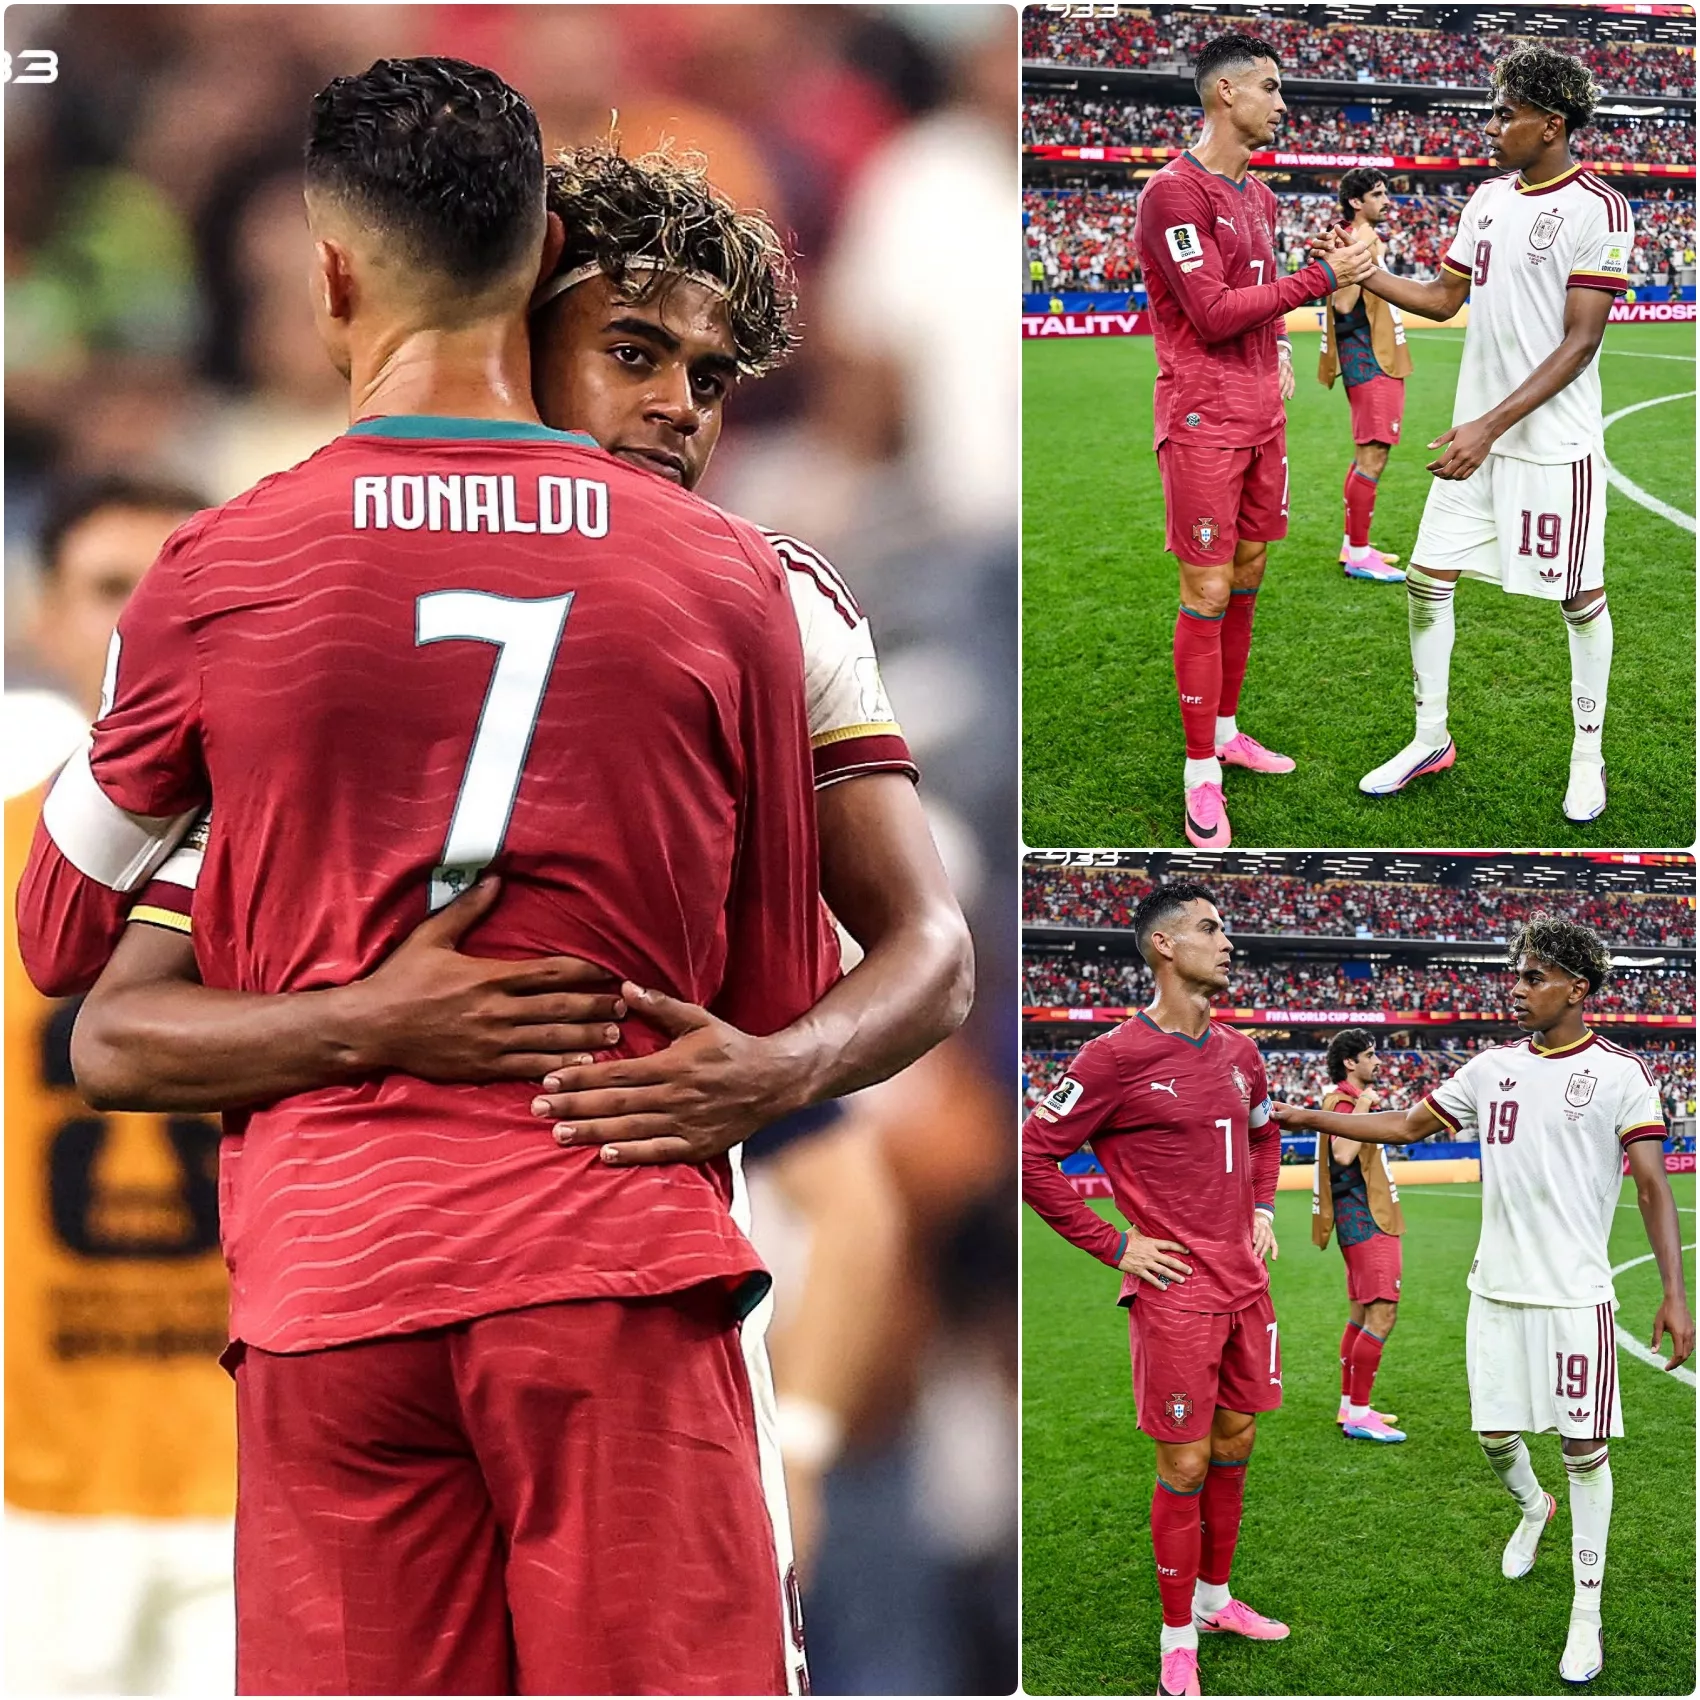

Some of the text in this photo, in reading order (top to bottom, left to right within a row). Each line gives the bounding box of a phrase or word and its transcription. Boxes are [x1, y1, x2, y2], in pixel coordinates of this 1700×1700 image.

[1275, 154, 1299, 164] FIFA
[1299, 155, 1337, 165] WORLD
[1337, 156, 1358, 166] CUP
[1249, 259, 1265, 286] 7
[1022, 314, 1139, 335] TALITY
[353, 473, 610, 539] RONALDO
[1518, 509, 1562, 559] 19
[415, 588, 576, 914] 7
[1265, 1011, 1386, 1022] FIFA WORLD CUP 2026
[1214, 1117, 1233, 1174] 7
[1486, 1100, 1520, 1145] 19
[1266, 1321, 1278, 1374] 7
[1555, 1351, 1589, 1399] 19
